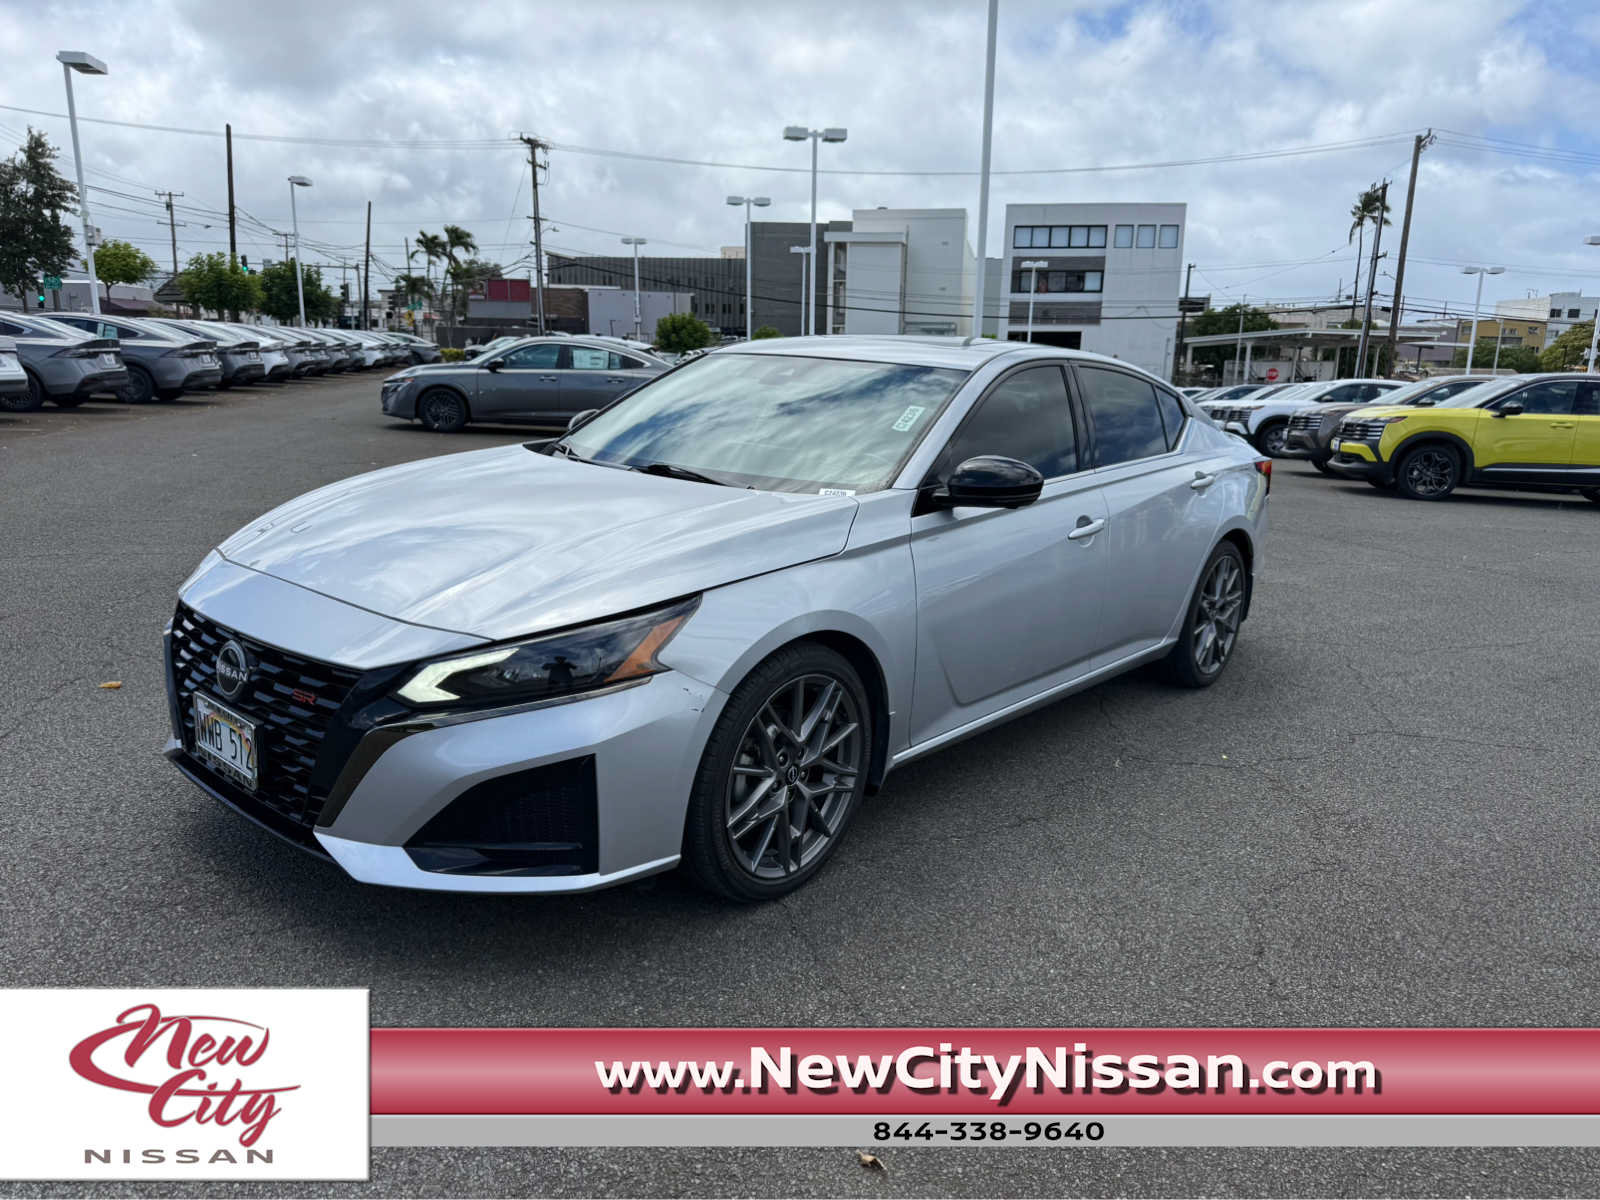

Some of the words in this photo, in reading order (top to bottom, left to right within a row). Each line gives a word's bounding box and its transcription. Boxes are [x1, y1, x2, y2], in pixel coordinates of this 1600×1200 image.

[216, 662, 248, 682] NISSAN
[292, 688, 316, 705] SR
[229, 727, 253, 771] 512
